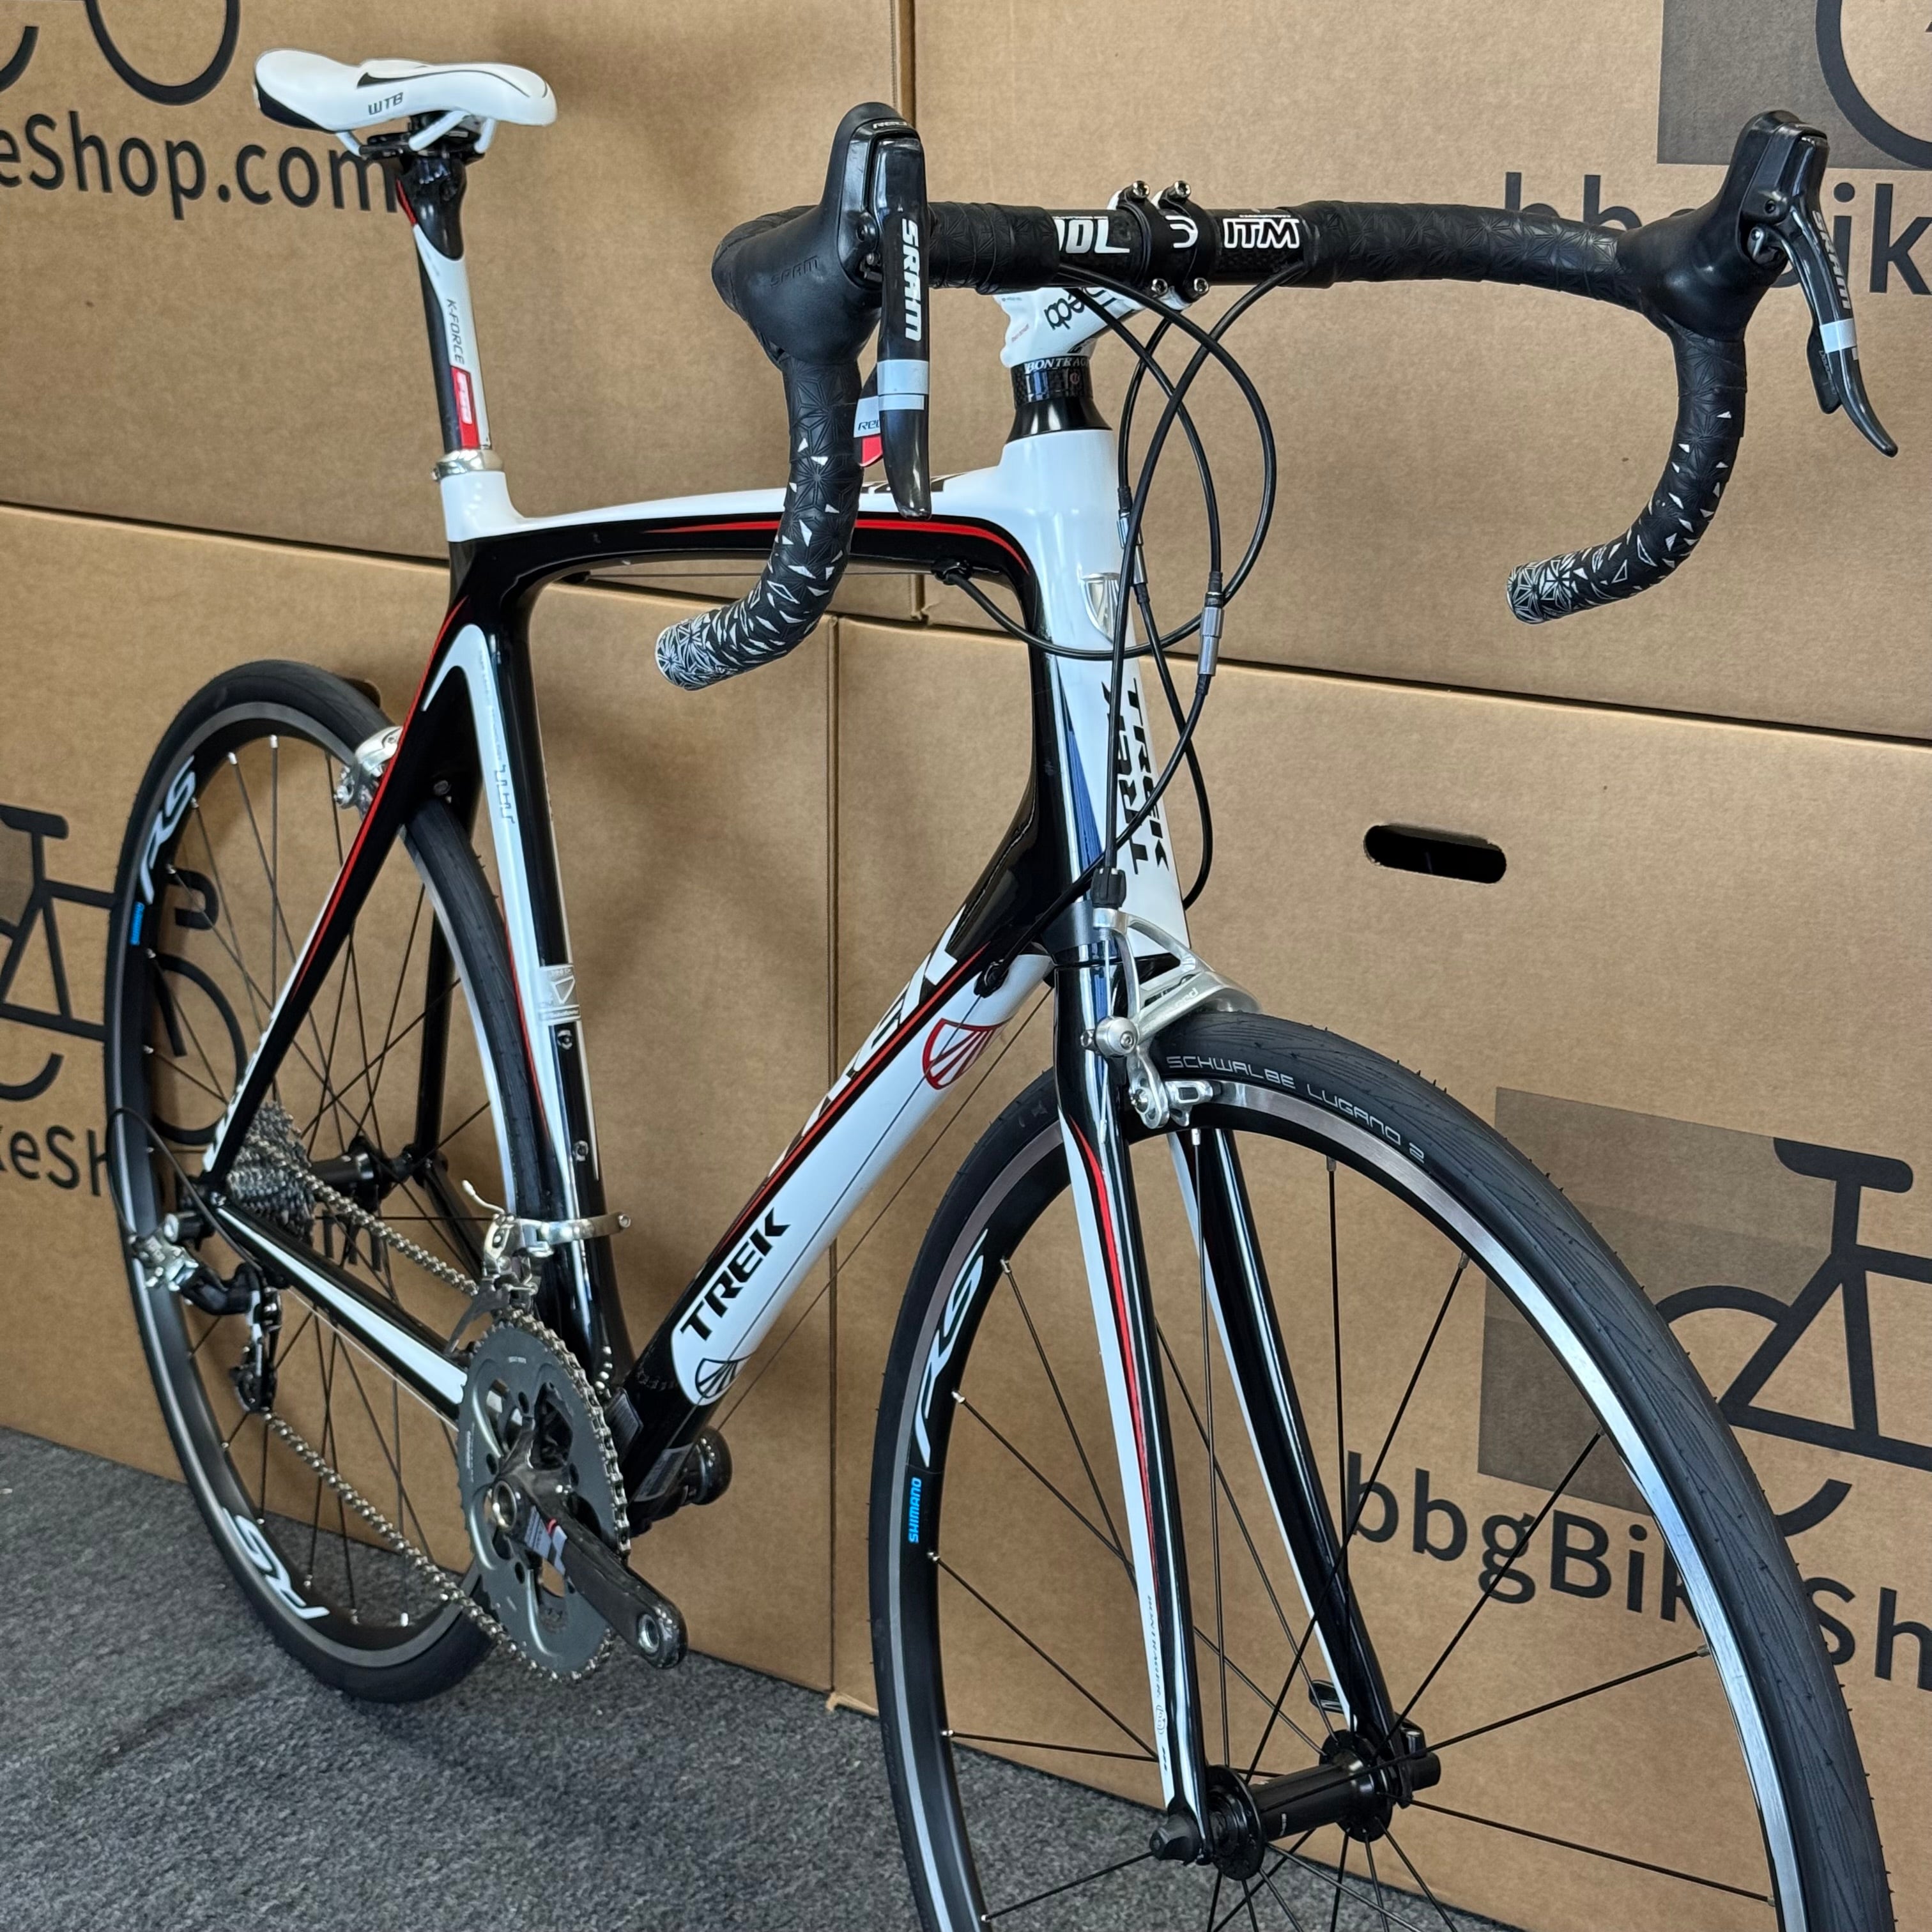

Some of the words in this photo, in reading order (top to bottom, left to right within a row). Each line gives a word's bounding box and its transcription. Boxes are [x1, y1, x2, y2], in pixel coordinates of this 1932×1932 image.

[368, 92, 404, 115] WTB
[1223, 218, 1300, 249] ITM
[769, 256, 820, 288] SRAM
[901, 218, 922, 342] SRAM
[446, 298, 465, 365] K-FORCE
[1024, 358, 1089, 374] BONTRAG
[1166, 1055, 1296, 1090] SCHWALBE
[1307, 1084, 1401, 1146] LUGANO
[680, 1207, 792, 1342] TREK
[908, 1476, 922, 1544] SHIMANO
